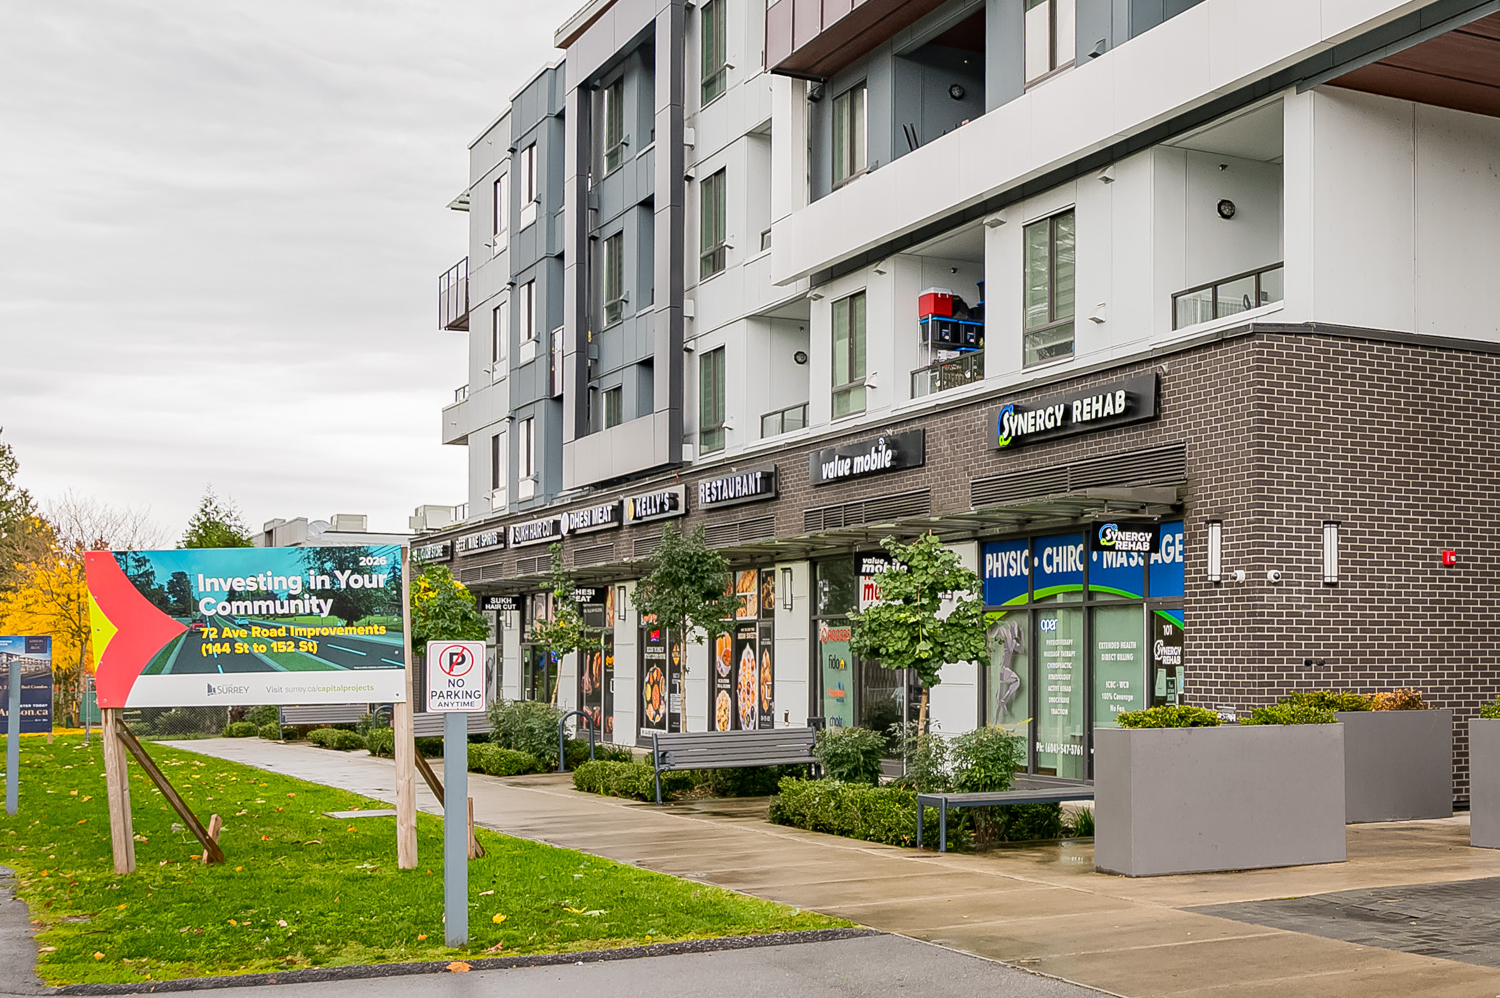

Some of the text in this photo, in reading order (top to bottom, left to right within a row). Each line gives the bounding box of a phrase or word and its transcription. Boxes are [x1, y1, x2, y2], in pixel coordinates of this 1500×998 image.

[1002, 390, 1126, 439] SYNERGY REHAB
[822, 444, 893, 480] value mobile
[700, 471, 762, 503] RESTAURANT
[635, 492, 670, 518] KELLY'S
[569, 505, 613, 530] DHESI MEAT
[514, 519, 554, 542] SUKH HAIR CUT
[1105, 528, 1152, 542] SYNERGY
[1115, 541, 1150, 551] REHAB
[359, 556, 387, 566] 2026
[197, 569, 388, 594] Investing in Your
[198, 594, 334, 618] Community
[200, 624, 387, 639] 72 Ave Road Improvements
[828, 629, 851, 642] ROGERS
[1163, 624, 1173, 636] 101
[201, 641, 318, 657] (144 St to 152 St)
[1157, 643, 1182, 656] SYNERGY
[828, 654, 840, 670] fido
[1162, 656, 1181, 664] REHAB
[217, 685, 250, 694] SURREY
[266, 684, 375, 694] Visit surrey.ca/capitalprojects
[447, 678, 465, 688] NO
[431, 690, 482, 700] PARKING
